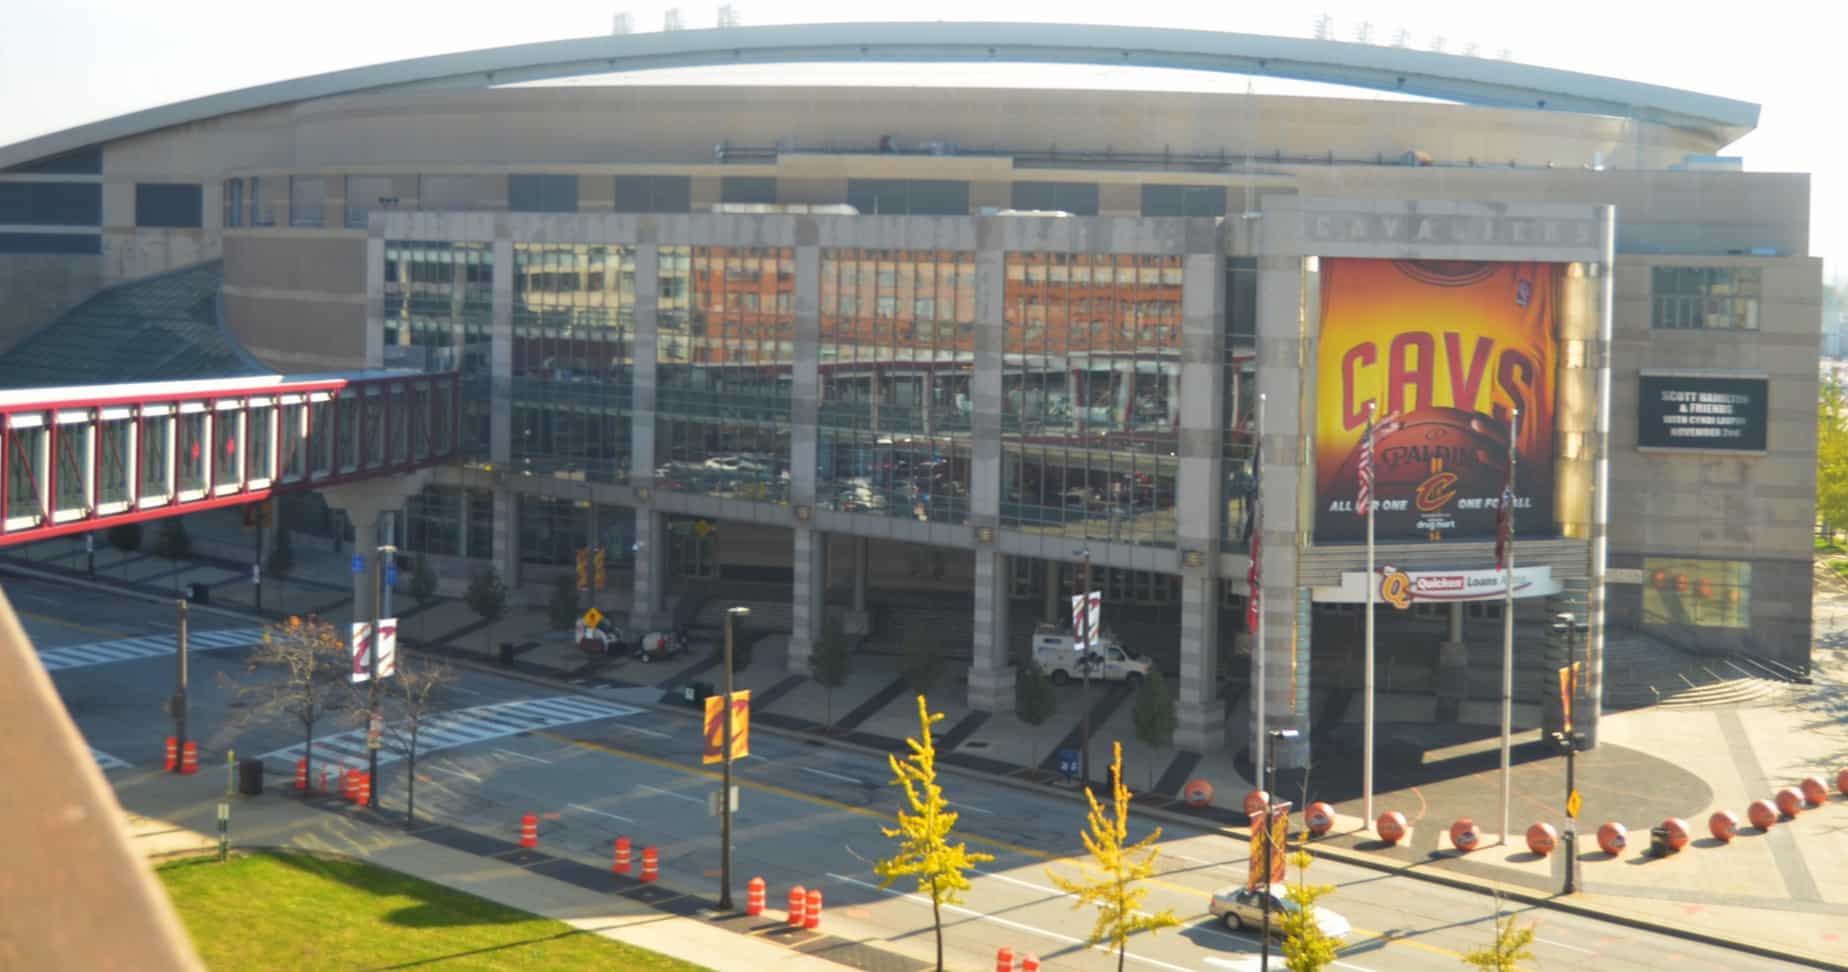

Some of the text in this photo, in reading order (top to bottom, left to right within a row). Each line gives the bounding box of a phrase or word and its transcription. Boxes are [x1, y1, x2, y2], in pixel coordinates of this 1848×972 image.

[1342, 331, 1533, 432] CAVS
[1662, 391, 1697, 401] SCOTT
[1329, 501, 1351, 511] ALL
[1382, 500, 1409, 511] ONE
[1458, 498, 1482, 509] ONE
[1467, 576, 1497, 587] Loans
[1382, 571, 1410, 609] Q
